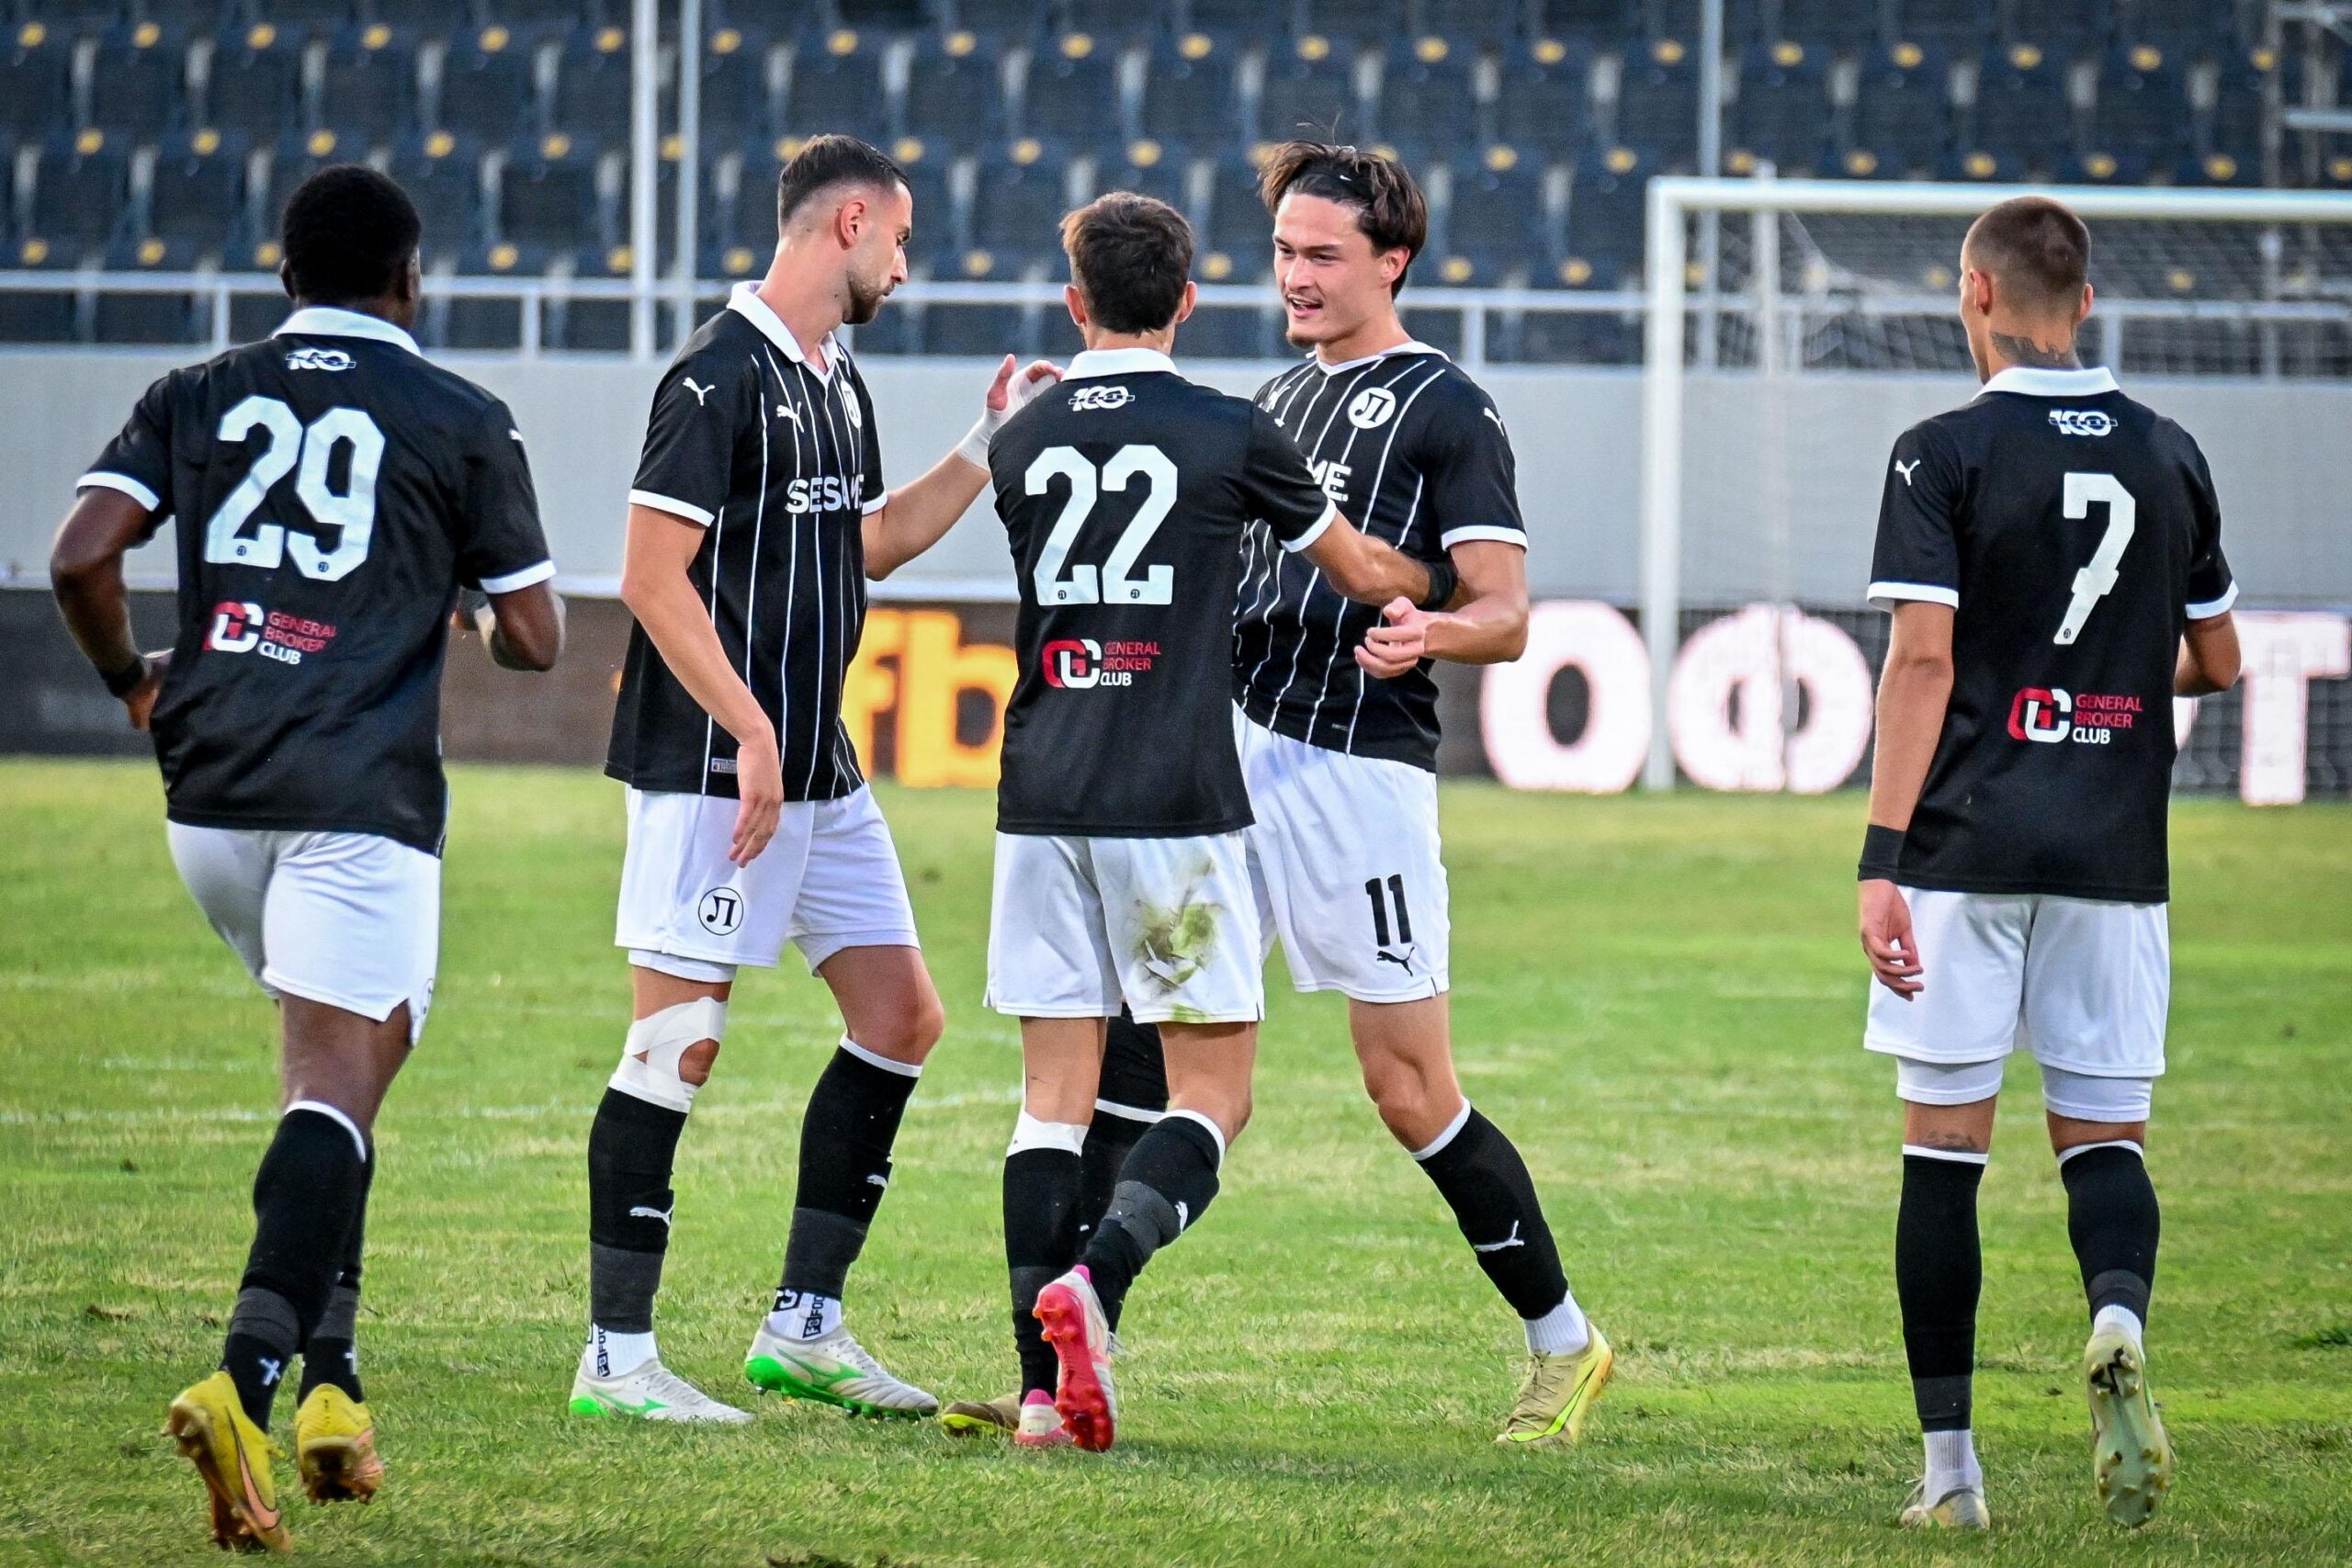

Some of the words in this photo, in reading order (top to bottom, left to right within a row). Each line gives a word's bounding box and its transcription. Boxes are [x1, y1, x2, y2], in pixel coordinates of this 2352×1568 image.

[205, 394, 385, 581] 29
[1024, 444, 1179, 606] 22
[2053, 471, 2136, 645] 7
[267, 610, 339, 638] GENERAL
[263, 626, 327, 653] BROKER
[1104, 641, 1162, 655] GENERAL
[257, 641, 302, 665] CLUB
[1102, 657, 1152, 671] BROKER
[1100, 671, 1133, 686] CLUB
[2075, 694, 2143, 712] GENERAL
[2074, 710, 2133, 728] BROKER
[2072, 727, 2111, 745] CLUB
[1364, 874, 1413, 947] 11
